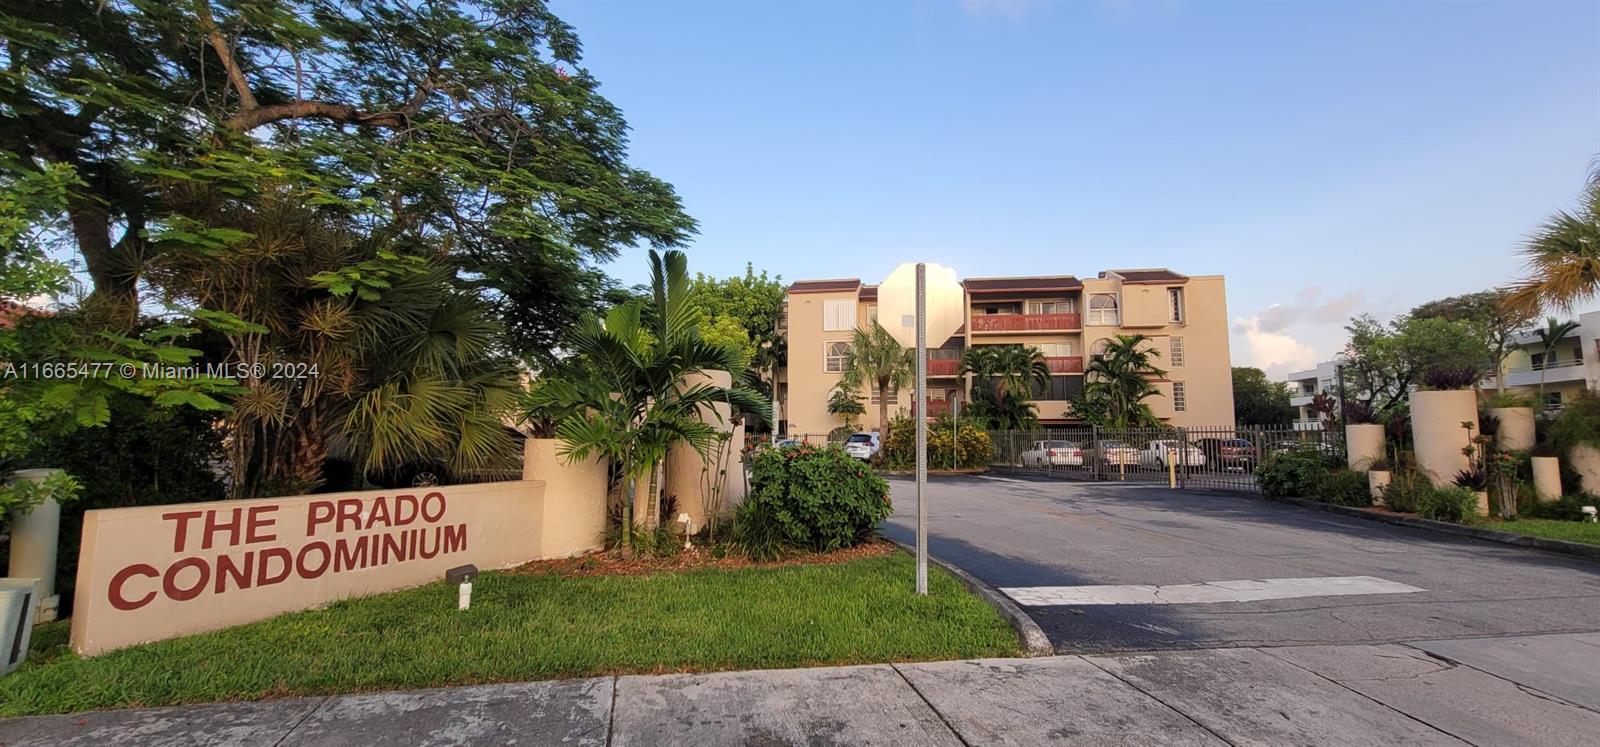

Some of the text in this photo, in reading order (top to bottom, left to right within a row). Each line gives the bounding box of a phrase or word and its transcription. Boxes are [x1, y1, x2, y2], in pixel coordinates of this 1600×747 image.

[162, 492, 446, 553] THE PRADO
[108, 524, 467, 611] CONDOMINIUM
